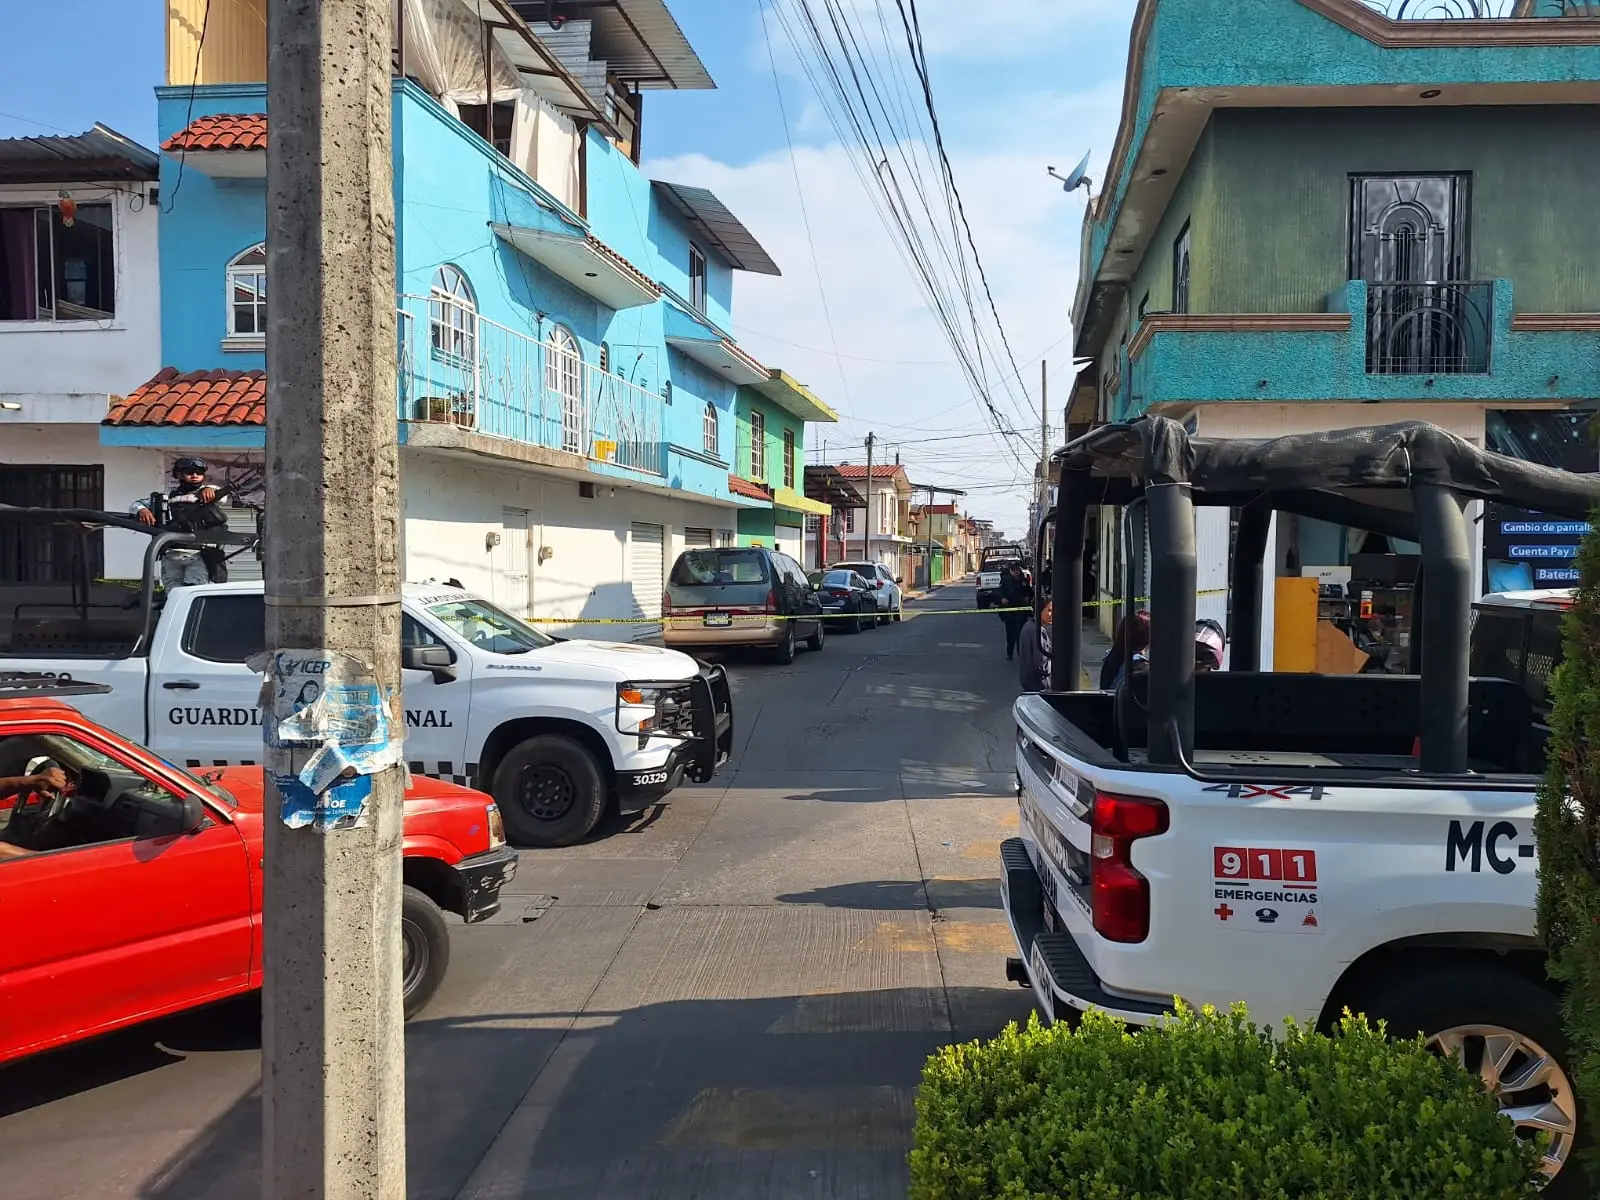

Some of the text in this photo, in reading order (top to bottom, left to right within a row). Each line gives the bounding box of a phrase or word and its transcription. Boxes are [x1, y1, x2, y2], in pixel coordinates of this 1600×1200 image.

[1503, 523, 1540, 532] Cambio
[1543, 523, 1555, 532] de
[1511, 547, 1570, 558] Cuenta Pay
[168, 706, 264, 726] GUARDI
[632, 772, 668, 786] 30329
[1221, 852, 1306, 878] 911
[1214, 888, 1318, 904] EMERGENCIAS
